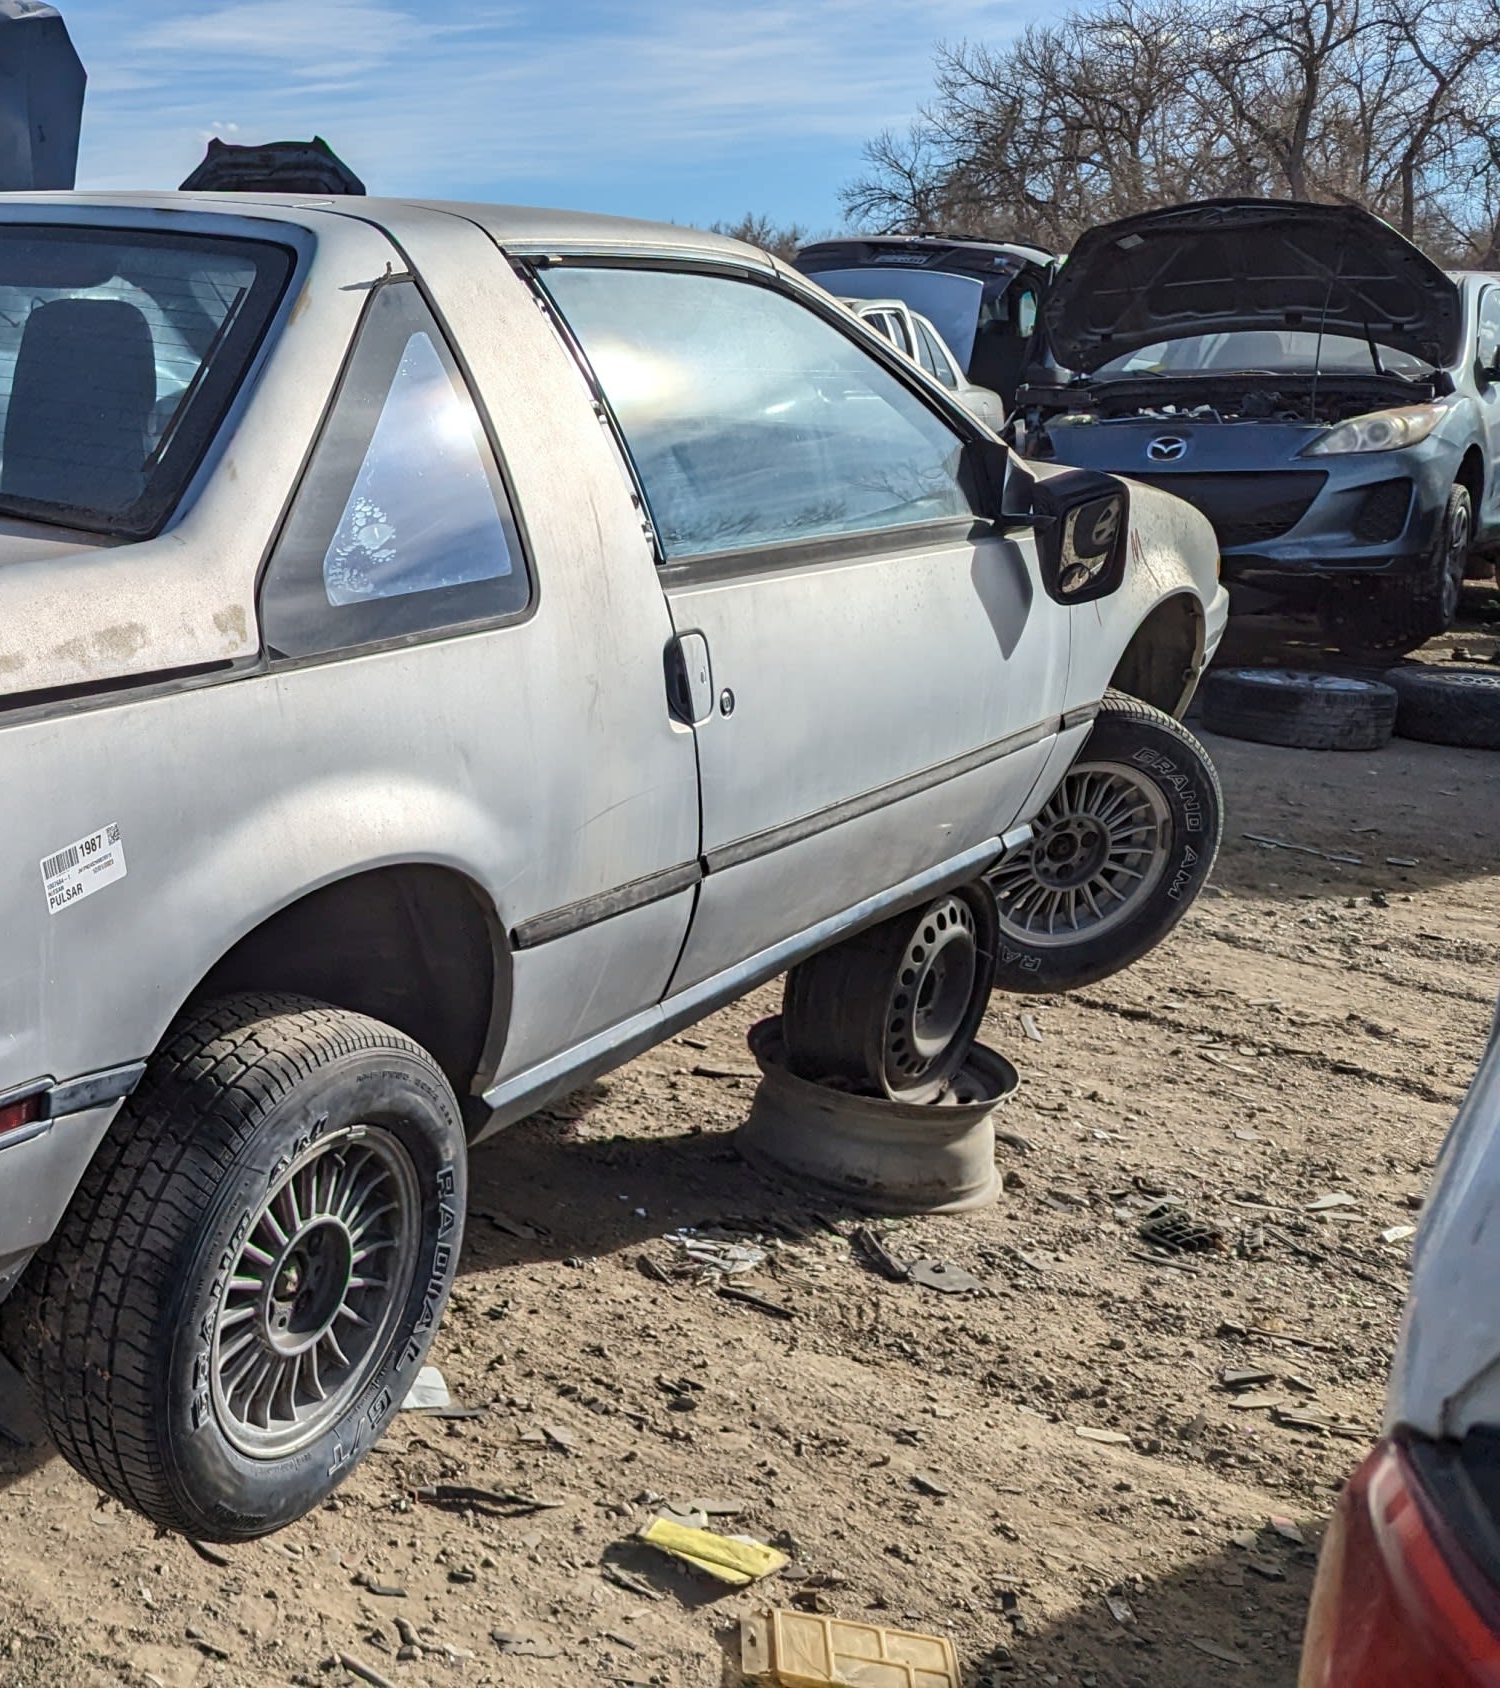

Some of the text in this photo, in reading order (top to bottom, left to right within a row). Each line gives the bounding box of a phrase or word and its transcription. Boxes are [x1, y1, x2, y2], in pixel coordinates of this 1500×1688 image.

[79, 834, 102, 857] 1987
[1132, 747, 1201, 901] GRAND AM
[49, 883, 83, 909] PULSAR
[395, 1165, 456, 1372] RADIAL
[327, 1384, 392, 1477] G/T
